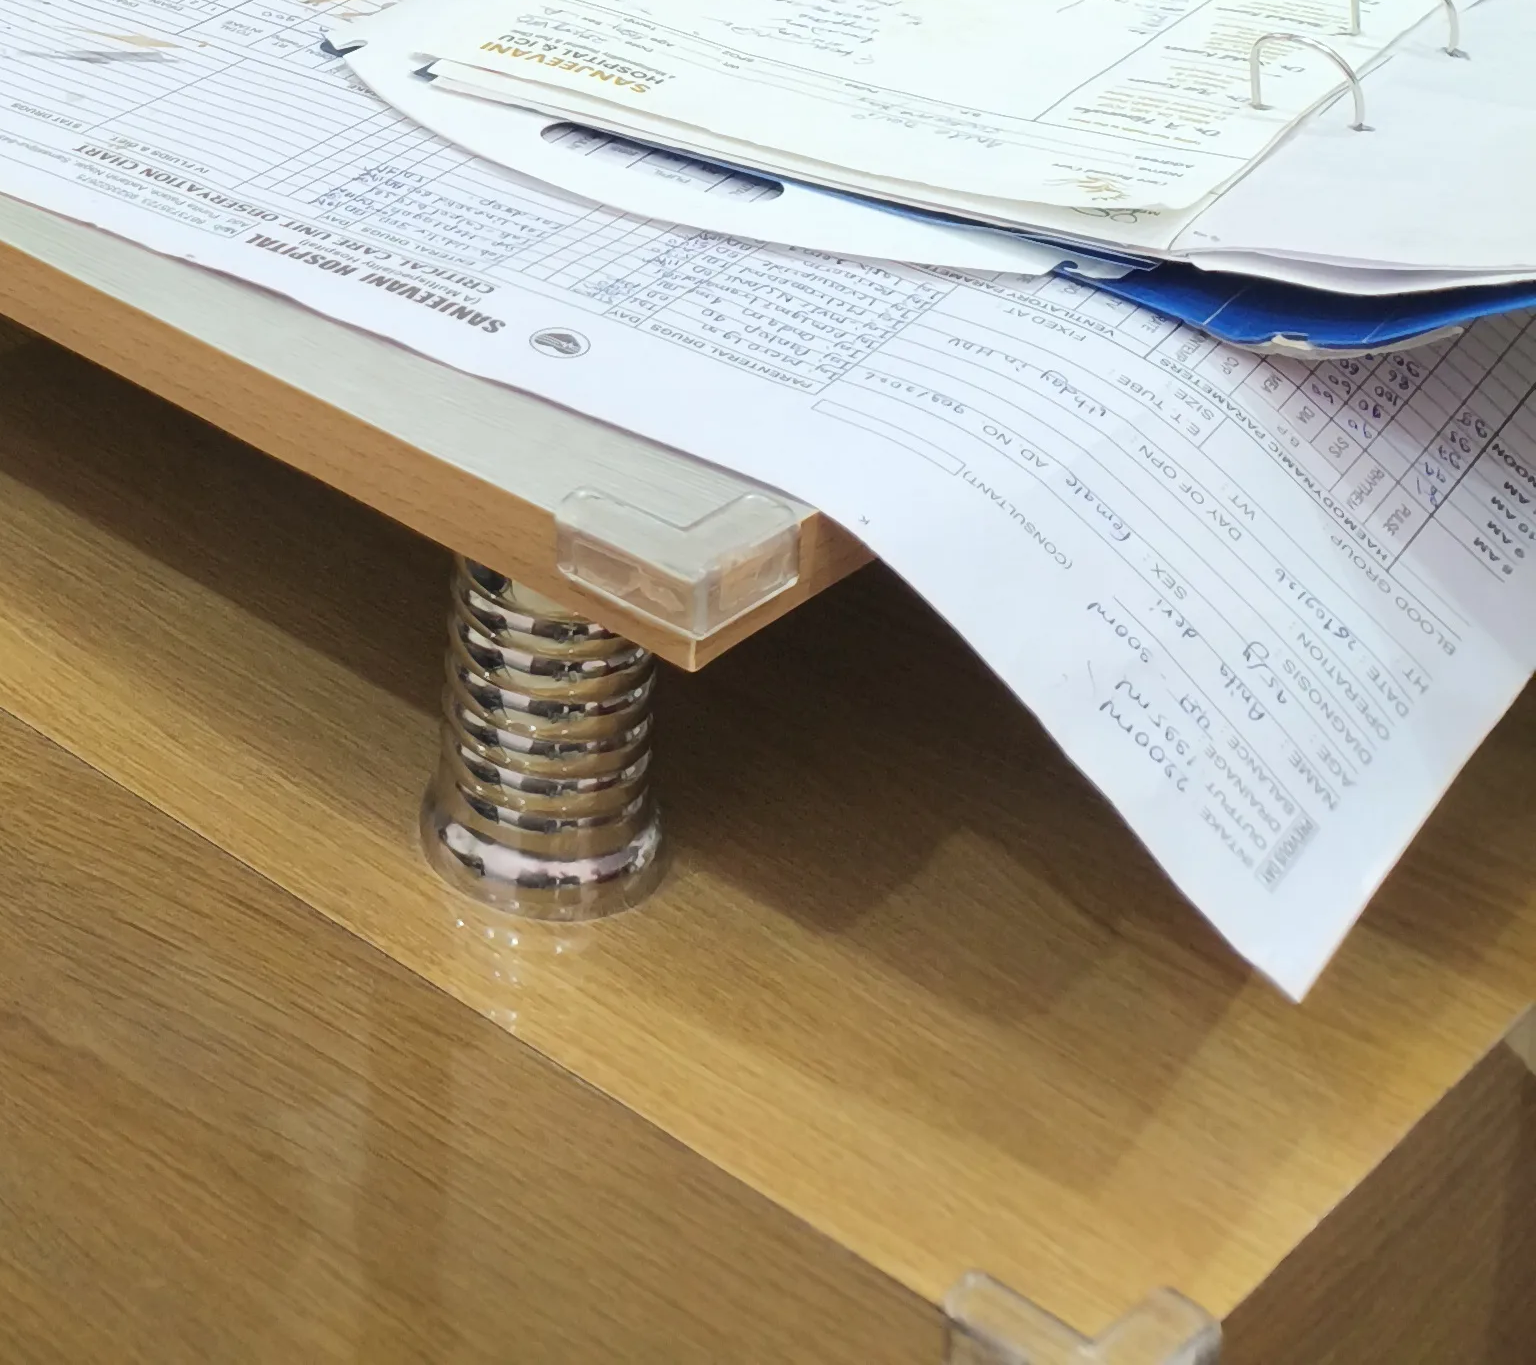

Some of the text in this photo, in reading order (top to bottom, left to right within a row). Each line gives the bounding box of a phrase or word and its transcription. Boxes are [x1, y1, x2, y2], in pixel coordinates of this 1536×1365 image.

[479, 40, 651, 94] SANJEEVANI
[498, 33, 665, 85] HOSPITAL & ICU
[52, 115, 82, 129] STAT
[151, 149, 196, 170] FLUIDS
[71, 144, 496, 295] CRITICAL CARE UNIT OBSERVATION CHART
[323, 214, 351, 227] DAY
[360, 227, 410, 247] DRUGS
[243, 233, 506, 333] SANJEEVANI HOSPITAL
[607, 309, 641, 325] DAY
[1006, 291, 1115, 338] VENTILATORY
[1006, 307, 1087, 343] FIXED AT
[650, 324, 813, 389] PARENTERAL DRUGS
[1117, 373, 1165, 411] TUBE
[1158, 358, 1266, 449] PARAMETERS
[1173, 390, 1215, 422] SIZE
[1138, 443, 1242, 541] DAY OF OPN
[1227, 493, 1257, 521] WT
[1267, 441, 1390, 562] HAEMODYNAMIC
[1491, 497, 1516, 519] AM
[1504, 481, 1530, 504] AM
[961, 470, 1073, 570] (CONSULTANT)
[1381, 503, 1412, 537] PULSE
[1487, 521, 1512, 544] AM
[1474, 537, 1500, 562] AM
[1150, 563, 1188, 601] SEX
[1329, 535, 1458, 657] BLOOD GROUP
[1281, 657, 1373, 765] DIAGNOSIS
[1296, 630, 1390, 742] OPERATION
[1366, 664, 1409, 718] DATE
[1204, 745, 1282, 833] DRAINAGE
[1226, 736, 1296, 816] BALANCE
[1288, 752, 1340, 811] NAME
[1316, 745, 1353, 787] AGE
[1199, 806, 1255, 869] INTAKE
[1204, 781, 1269, 851] OUTPUT
